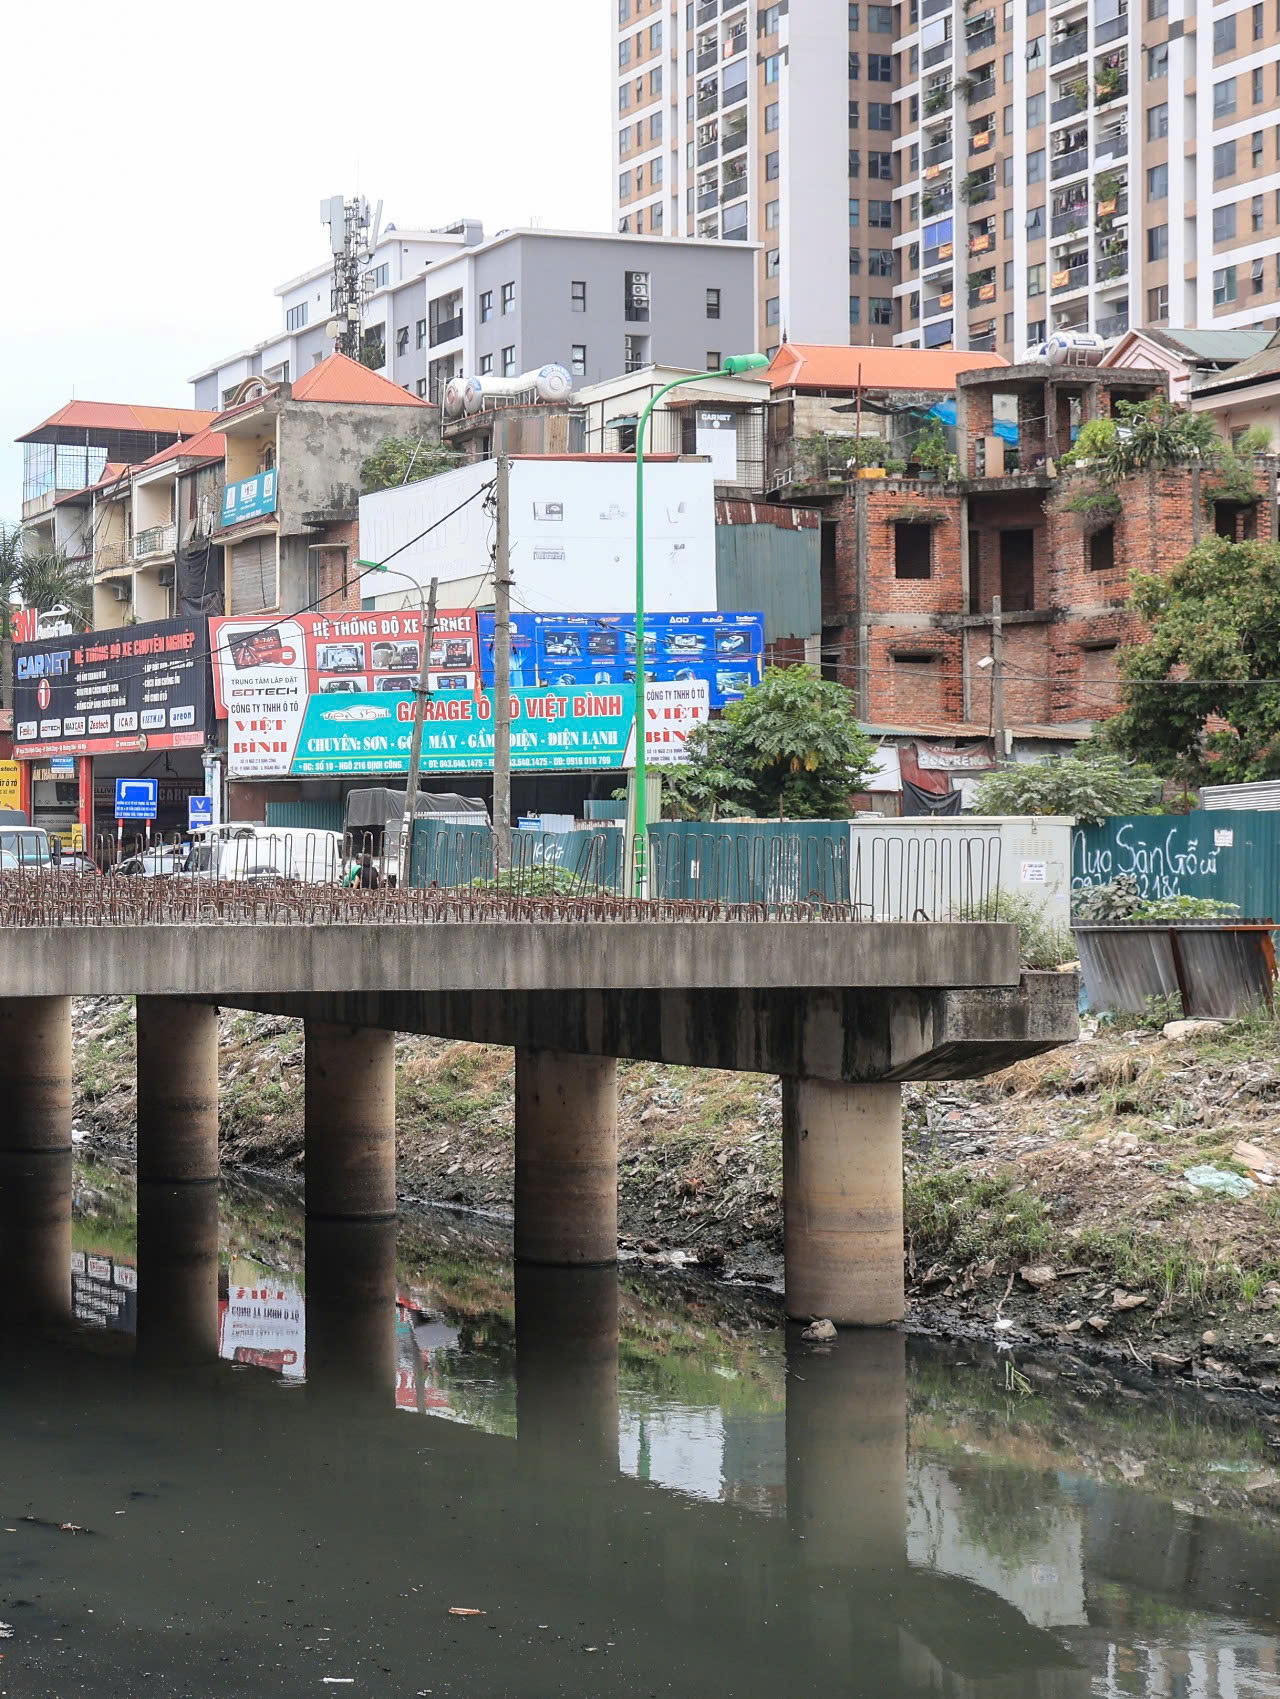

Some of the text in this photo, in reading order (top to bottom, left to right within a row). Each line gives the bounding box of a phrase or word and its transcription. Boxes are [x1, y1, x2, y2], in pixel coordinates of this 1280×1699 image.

[702, 413, 732, 421] CARNET
[12, 608, 37, 643] 3M
[312, 618, 330, 640] HỆ
[332, 618, 377, 637] THỐNG
[381, 617, 400, 638] ĐỘ
[404, 618, 419, 634] XE
[122, 642, 132, 658] XE
[133, 634, 164, 656] CHUYÊN
[165, 629, 196, 652] NGHIỆP
[18, 651, 71, 680] CARNET
[271, 676, 284, 684] LẮP
[285, 676, 298, 684] ĐẶT
[647, 687, 704, 700] CÔNG TY TNHH Ô TÔ
[231, 701, 298, 713] CÔNG TY TNHH Ô TÔ
[478, 694, 490, 720] Ô
[526, 694, 568, 722] VIỆT
[574, 692, 622, 718] BÌNH
[646, 704, 703, 722] VIỆT
[173, 712, 192, 720] areon
[90, 720, 108, 729] Zestech
[235, 717, 286, 734] VIỆT
[307, 734, 361, 752] CHUYÊN:
[363, 736, 388, 750] SƠN
[429, 730, 457, 748] MÁY
[548, 728, 580, 750] ĐIỆN
[583, 730, 618, 750] LẠNH
[646, 727, 686, 742] BÌN
[233, 739, 288, 753] BÌNH
[315, 760, 324, 770] SỐ
[338, 760, 353, 770] NGÕ
[355, 761, 365, 770] 216
[367, 761, 383, 770] ĐỊNH
[384, 759, 402, 769] CÔNG
[566, 756, 583, 765] 0916
[584, 756, 596, 764] 016
[599, 756, 611, 764] 799
